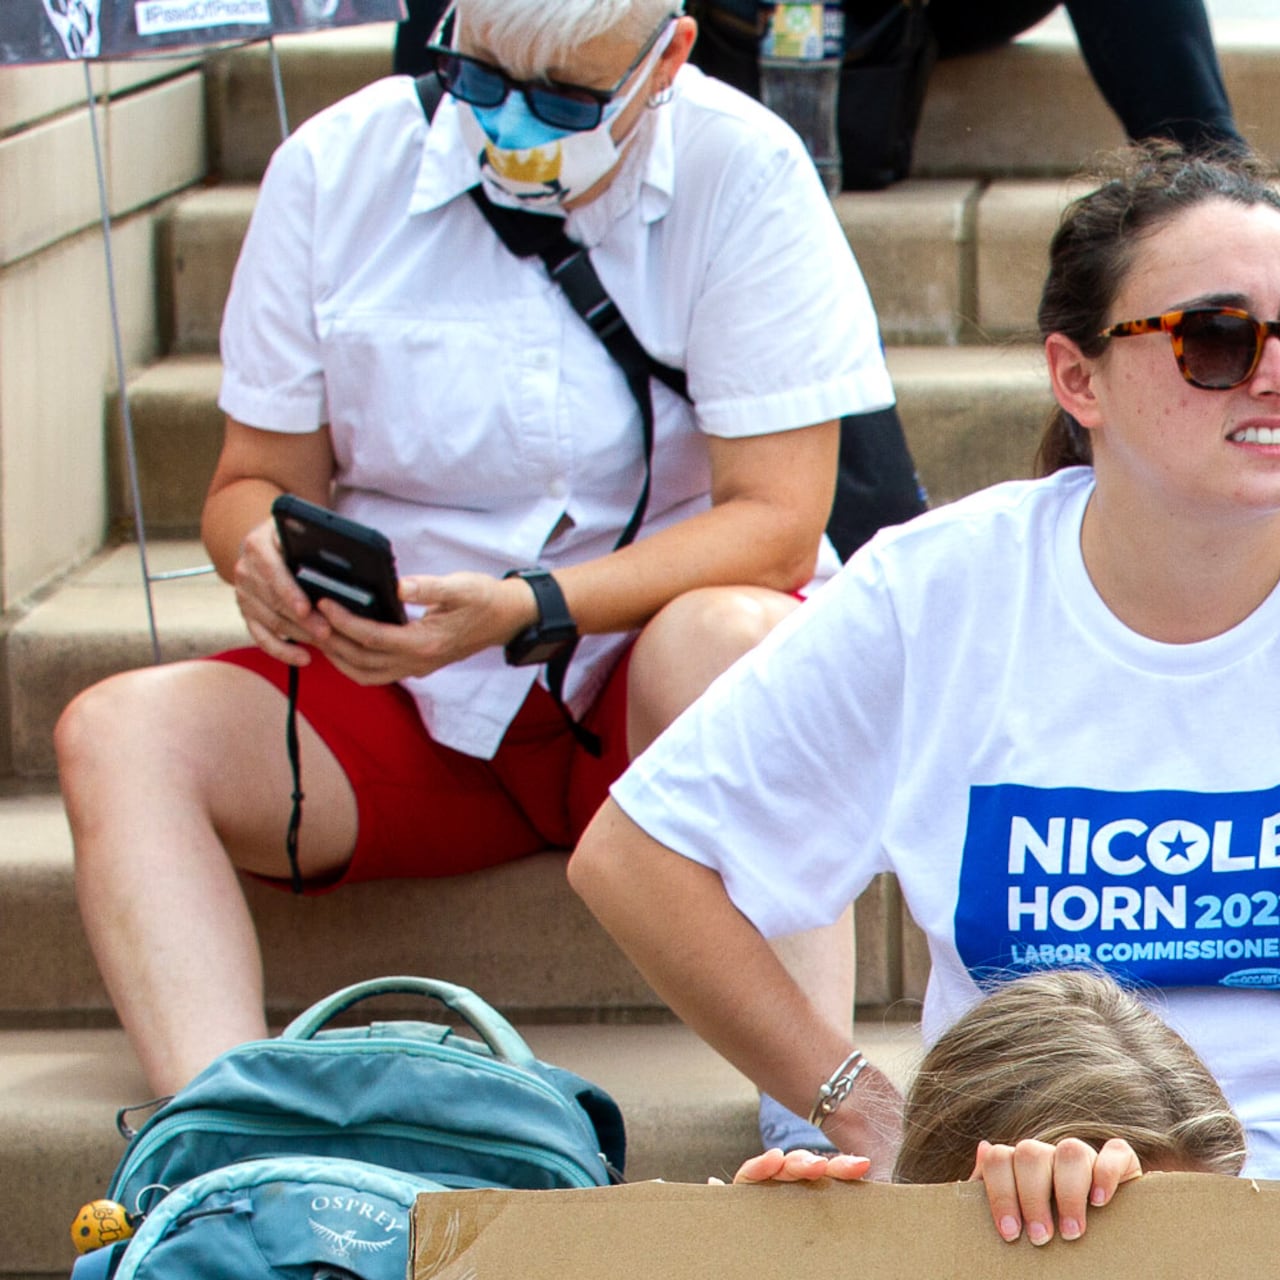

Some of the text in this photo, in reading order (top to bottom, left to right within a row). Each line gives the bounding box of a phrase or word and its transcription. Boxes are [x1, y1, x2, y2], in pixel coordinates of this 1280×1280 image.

[1007, 884, 1187, 932] HORN
[1011, 942, 1091, 966] LABOR
[311, 1196, 403, 1232] OSPREY
